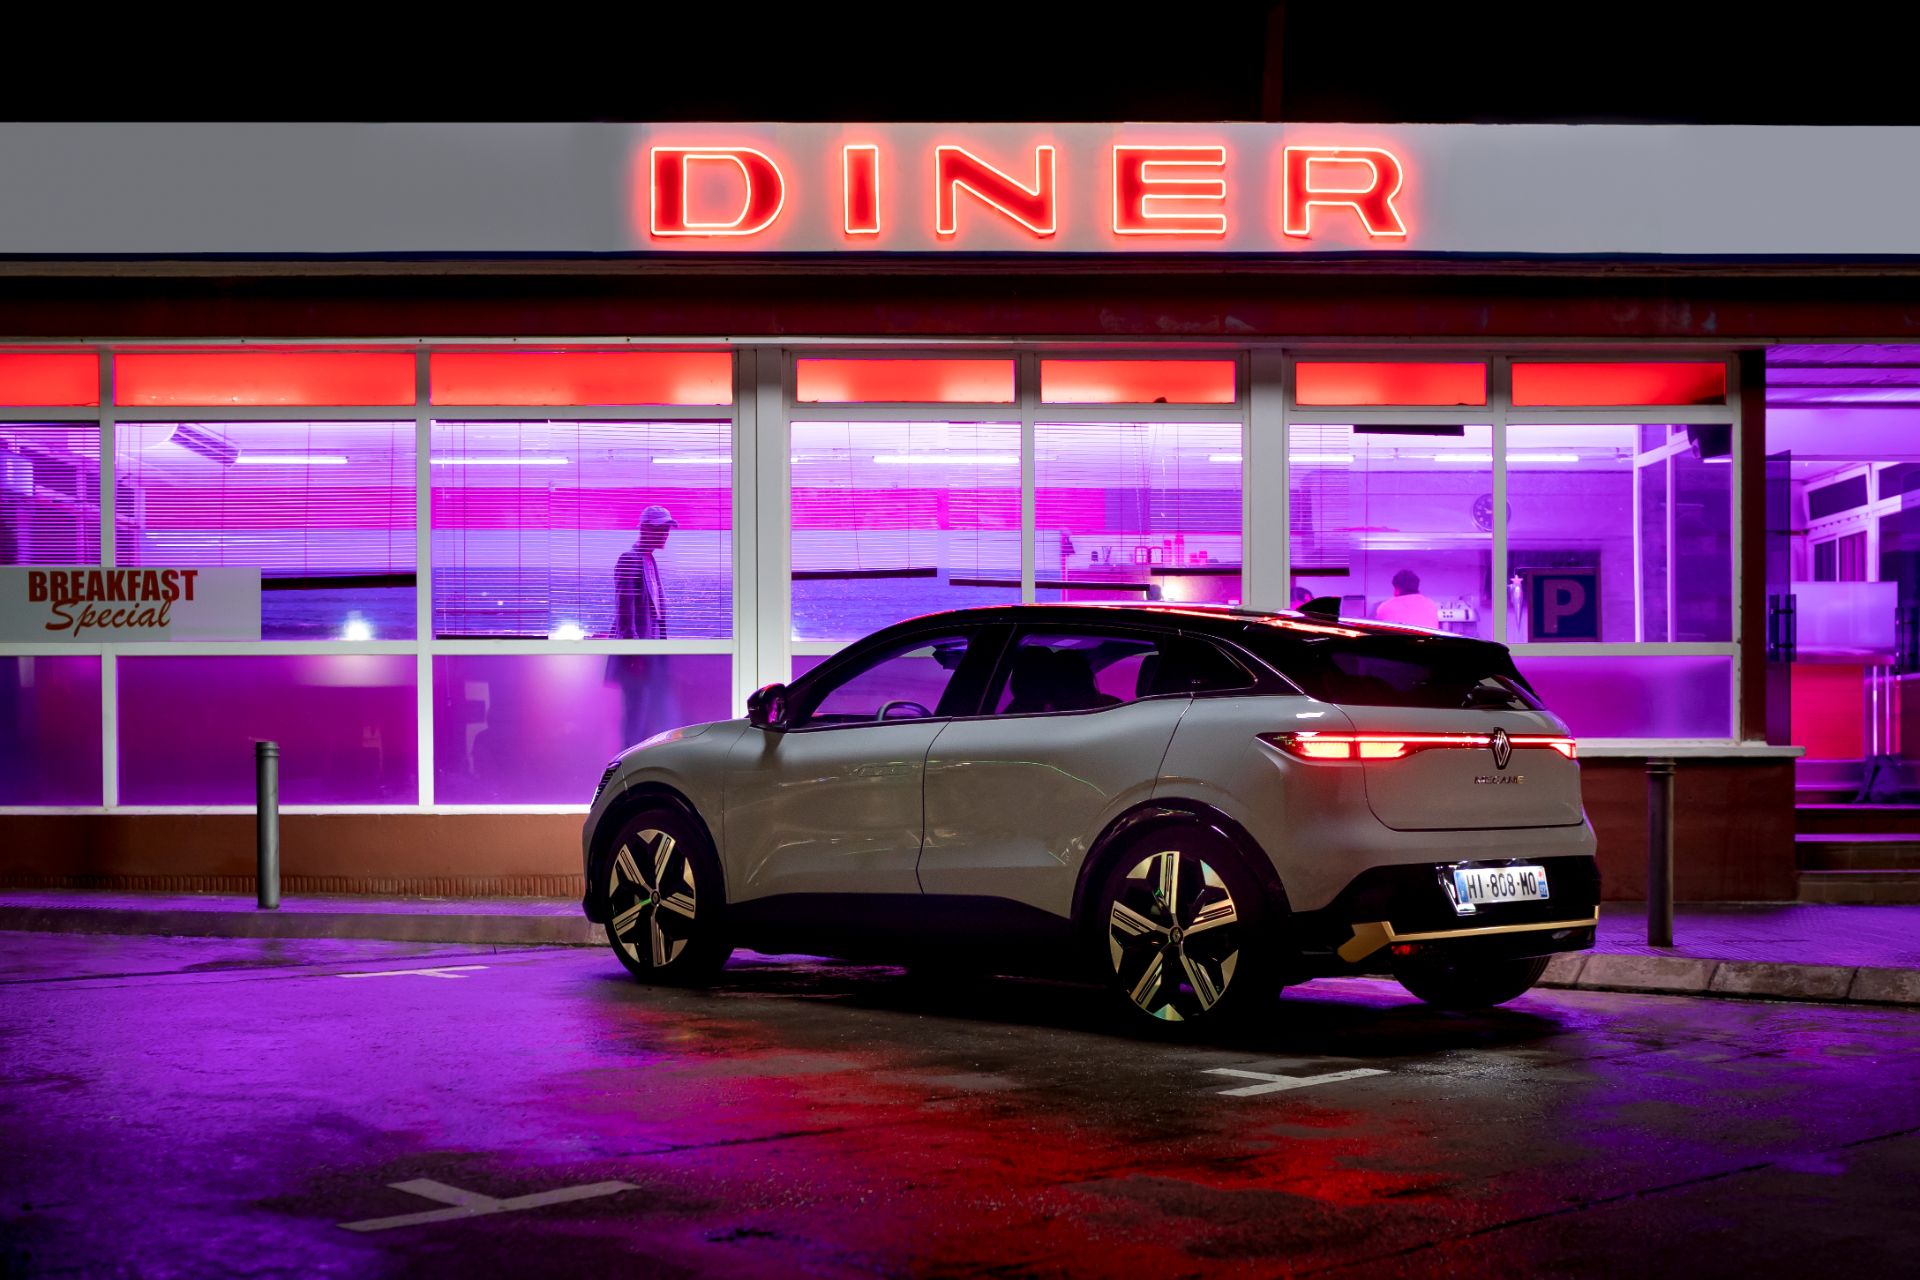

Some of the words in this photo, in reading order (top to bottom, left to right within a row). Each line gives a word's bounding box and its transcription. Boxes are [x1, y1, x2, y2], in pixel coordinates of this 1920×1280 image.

[649, 144, 1407, 238] DINER
[28, 569, 198, 602] BREAKFAST
[1544, 579, 1586, 634] P
[45, 597, 171, 638] Special
